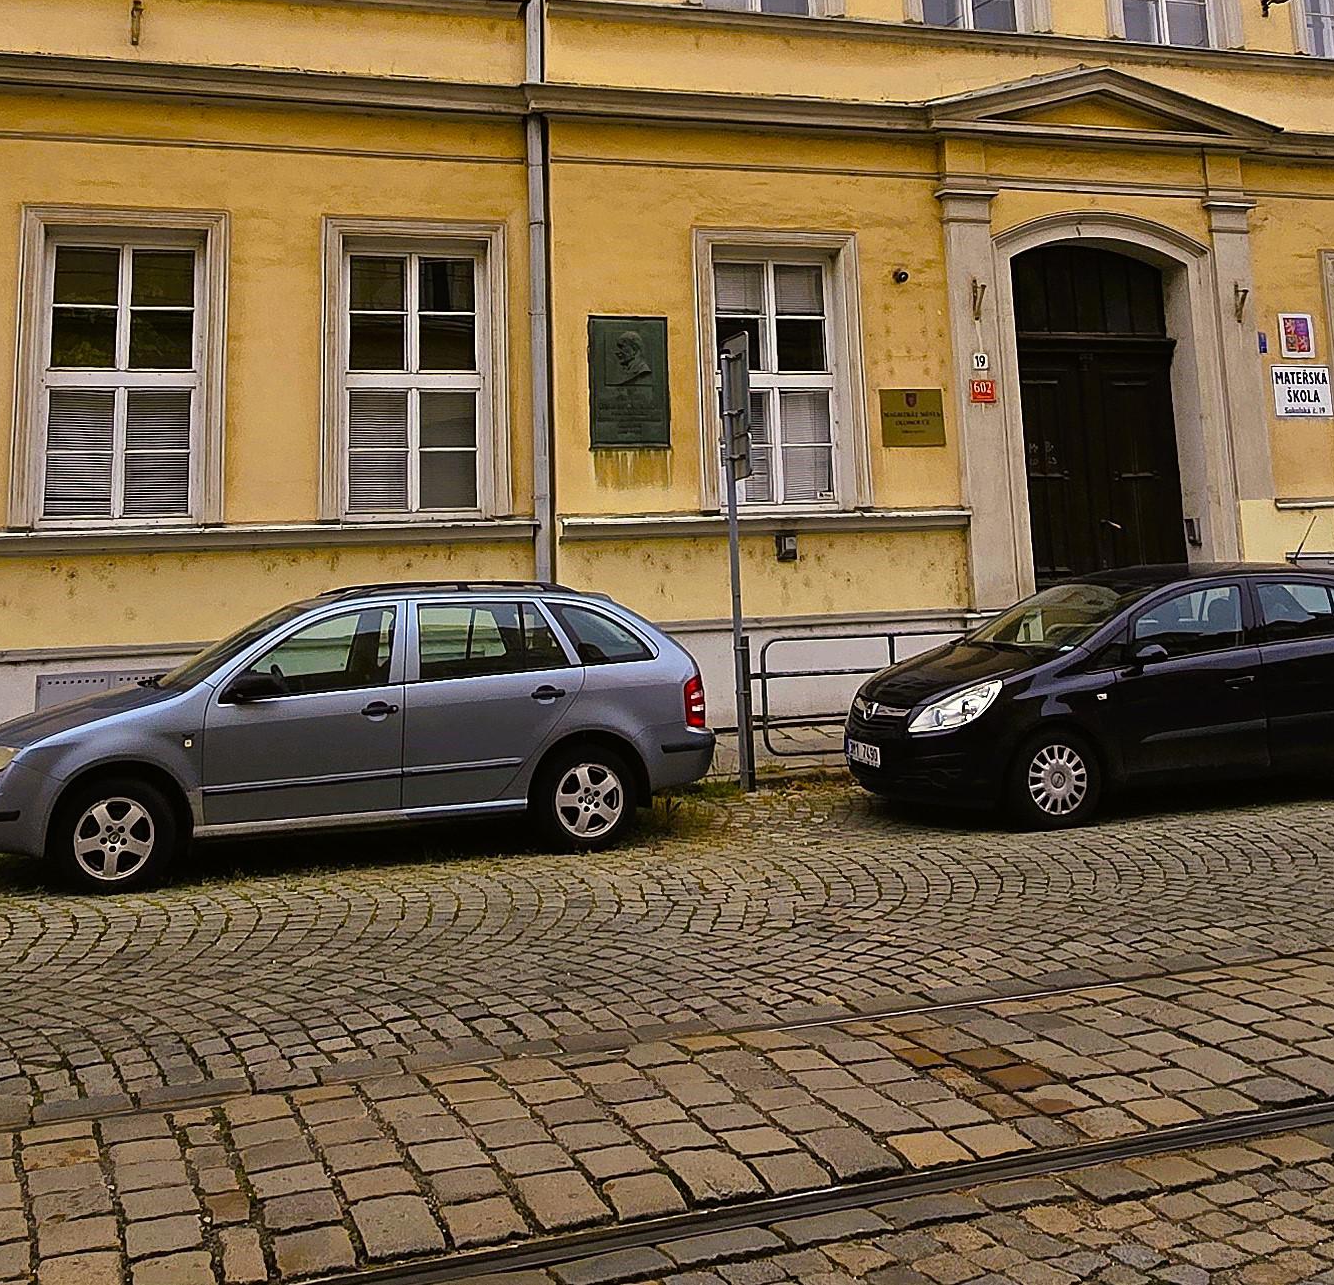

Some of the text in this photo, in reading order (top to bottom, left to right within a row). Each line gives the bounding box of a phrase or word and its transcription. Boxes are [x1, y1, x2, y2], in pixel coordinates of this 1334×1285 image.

[975, 355, 986, 367] 19
[1274, 369, 1328, 385] MATEŘSKÁ
[973, 381, 992, 394] 602
[1287, 387, 1321, 403] ŠKOLA
